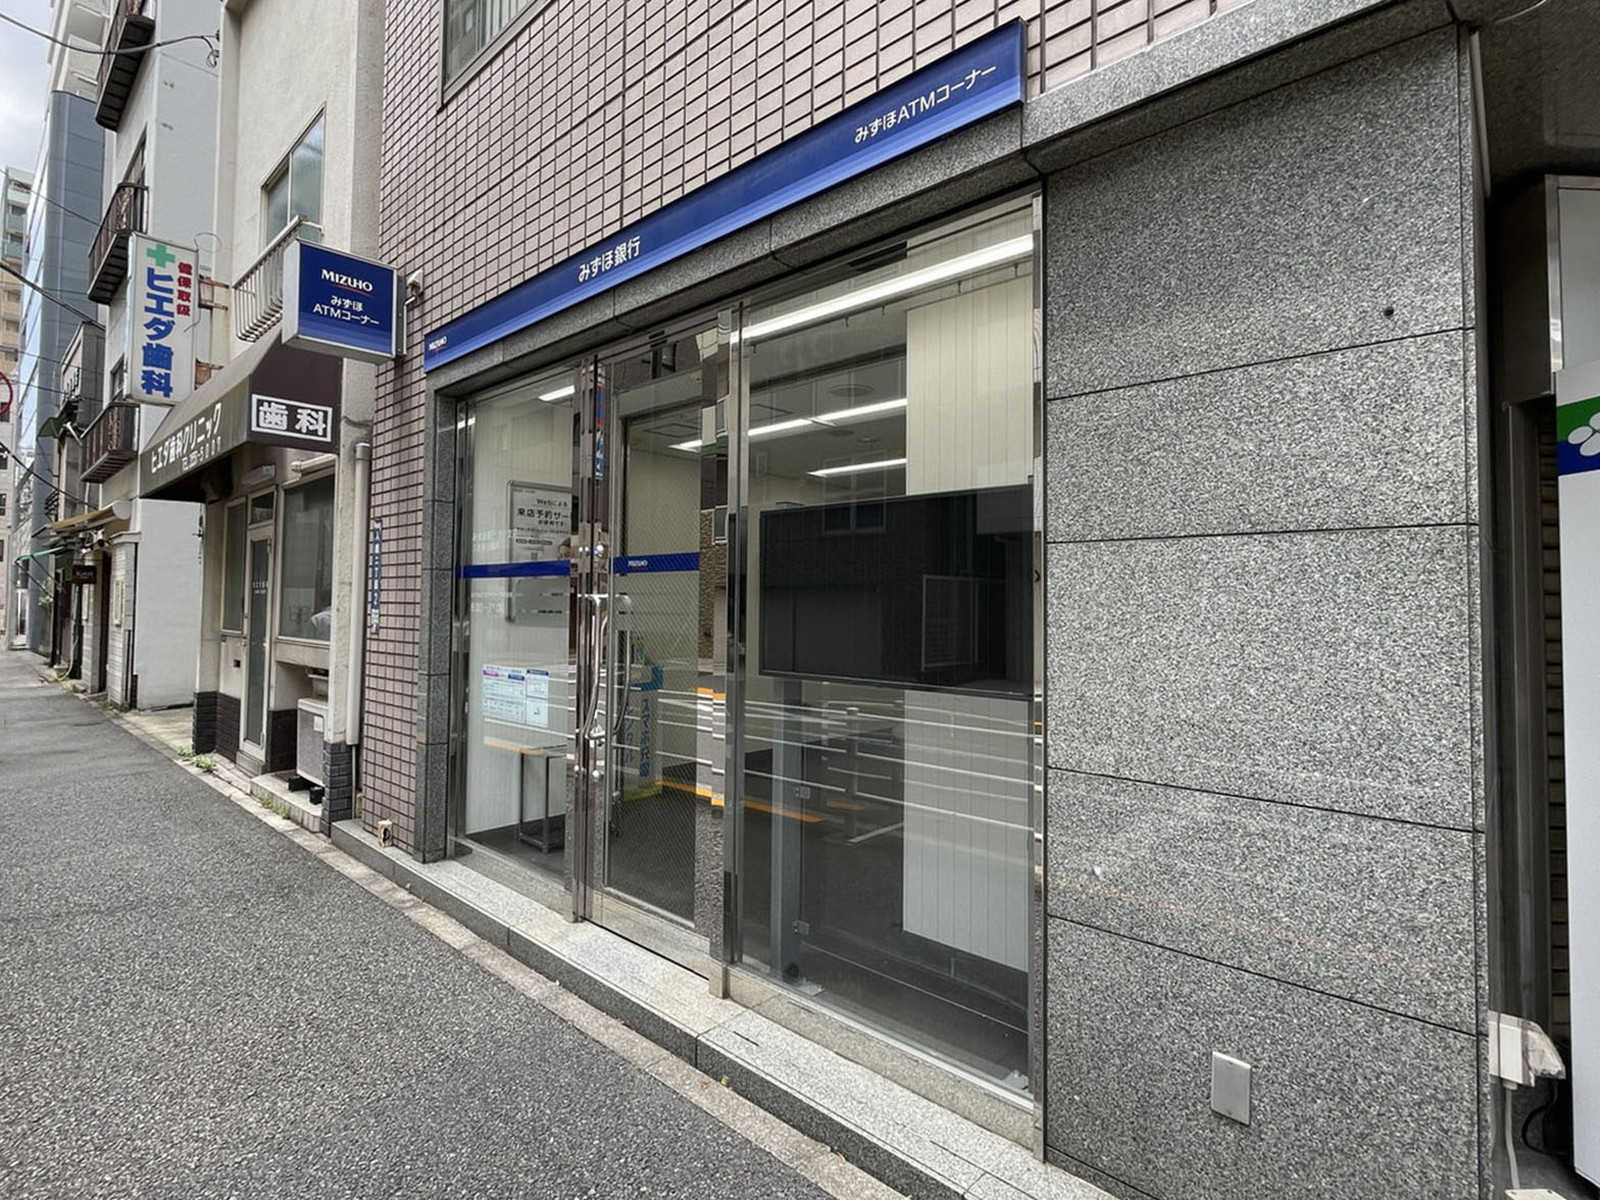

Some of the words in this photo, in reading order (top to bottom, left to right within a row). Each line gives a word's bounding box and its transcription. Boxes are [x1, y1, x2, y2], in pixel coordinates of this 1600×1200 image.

[854, 65, 997, 144] みずほATMコーナー
[578, 235, 641, 283] みずほ銀行
[321, 268, 374, 293] MIZUHO
[313, 303, 380, 326] ATMコーナー
[330, 295, 363, 312] みずほ
[141, 266, 175, 398] ヒエダ歯科
[151, 401, 222, 474] ヒエダ歯科クリニック
[259, 401, 327, 436] 歯科
